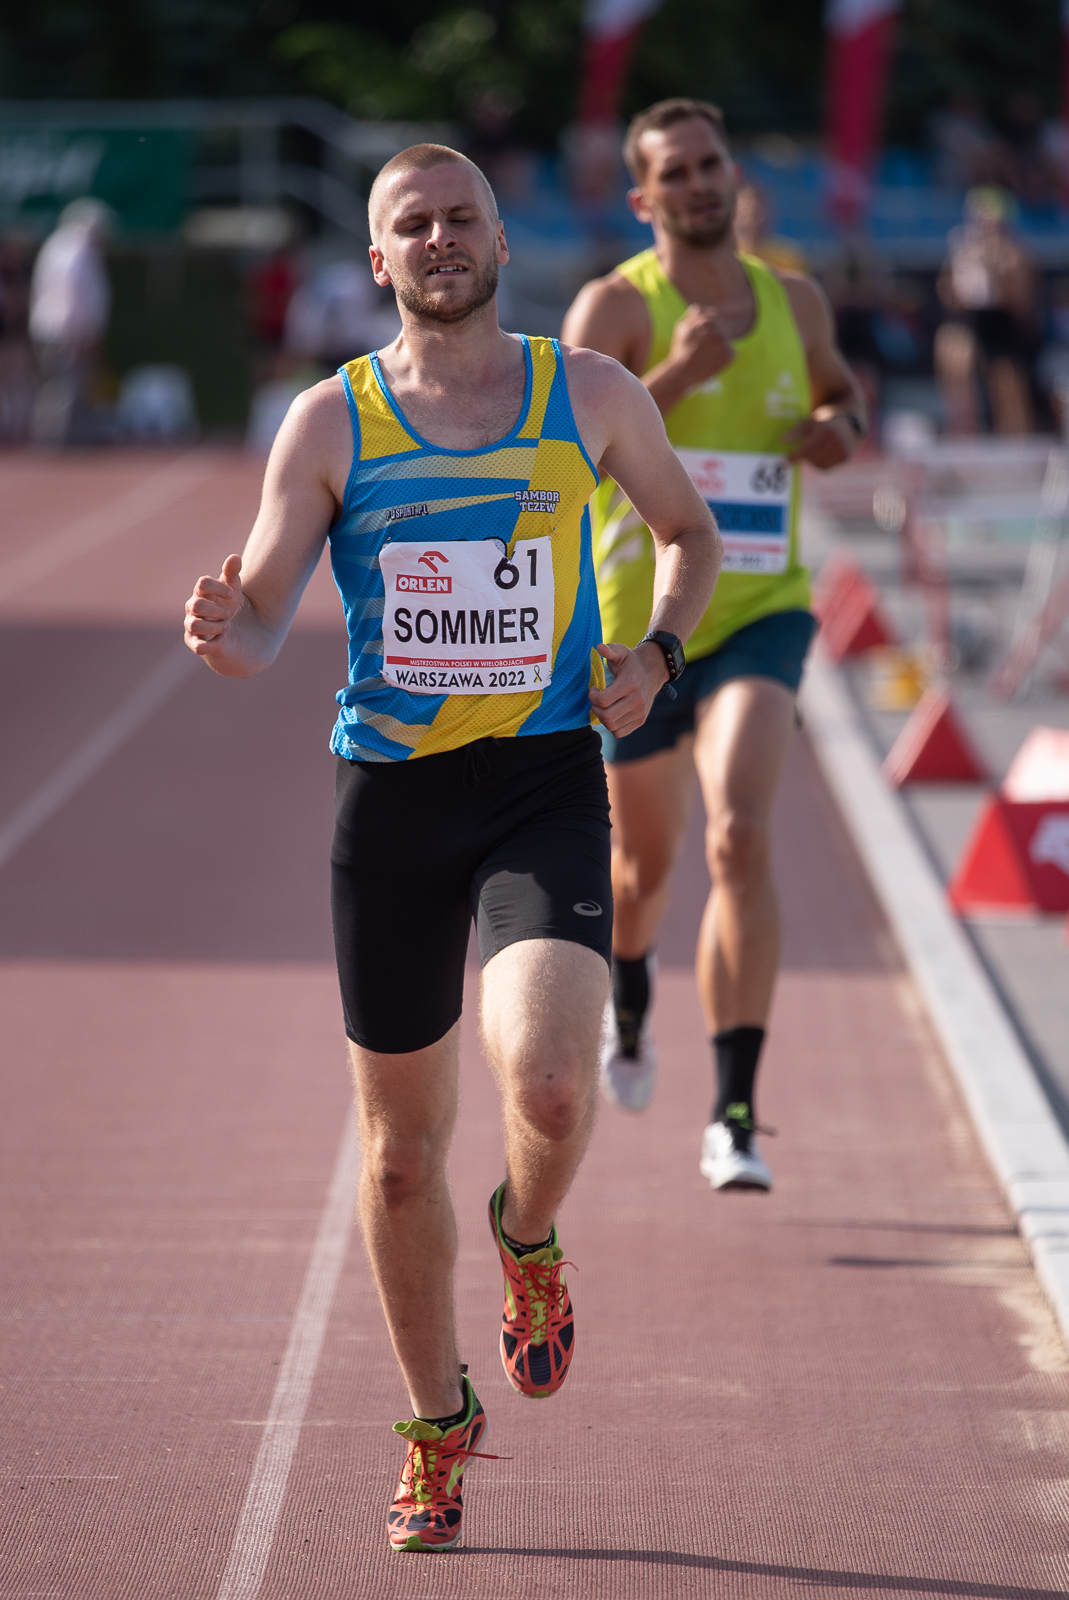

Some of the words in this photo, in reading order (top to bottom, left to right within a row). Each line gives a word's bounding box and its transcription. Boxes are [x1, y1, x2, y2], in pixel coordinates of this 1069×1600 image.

[751, 459, 787, 494] 68
[514, 490, 560, 502] SAMBOR
[519, 501, 556, 514] TCZEW
[493, 548, 538, 590] 61
[398, 576, 450, 592] ORLEN
[393, 607, 540, 645] SOMMER
[409, 659, 450, 667] MISTRZOSTWA
[395, 669, 484, 688] WARSZAWA
[488, 670, 526, 688] 2022
